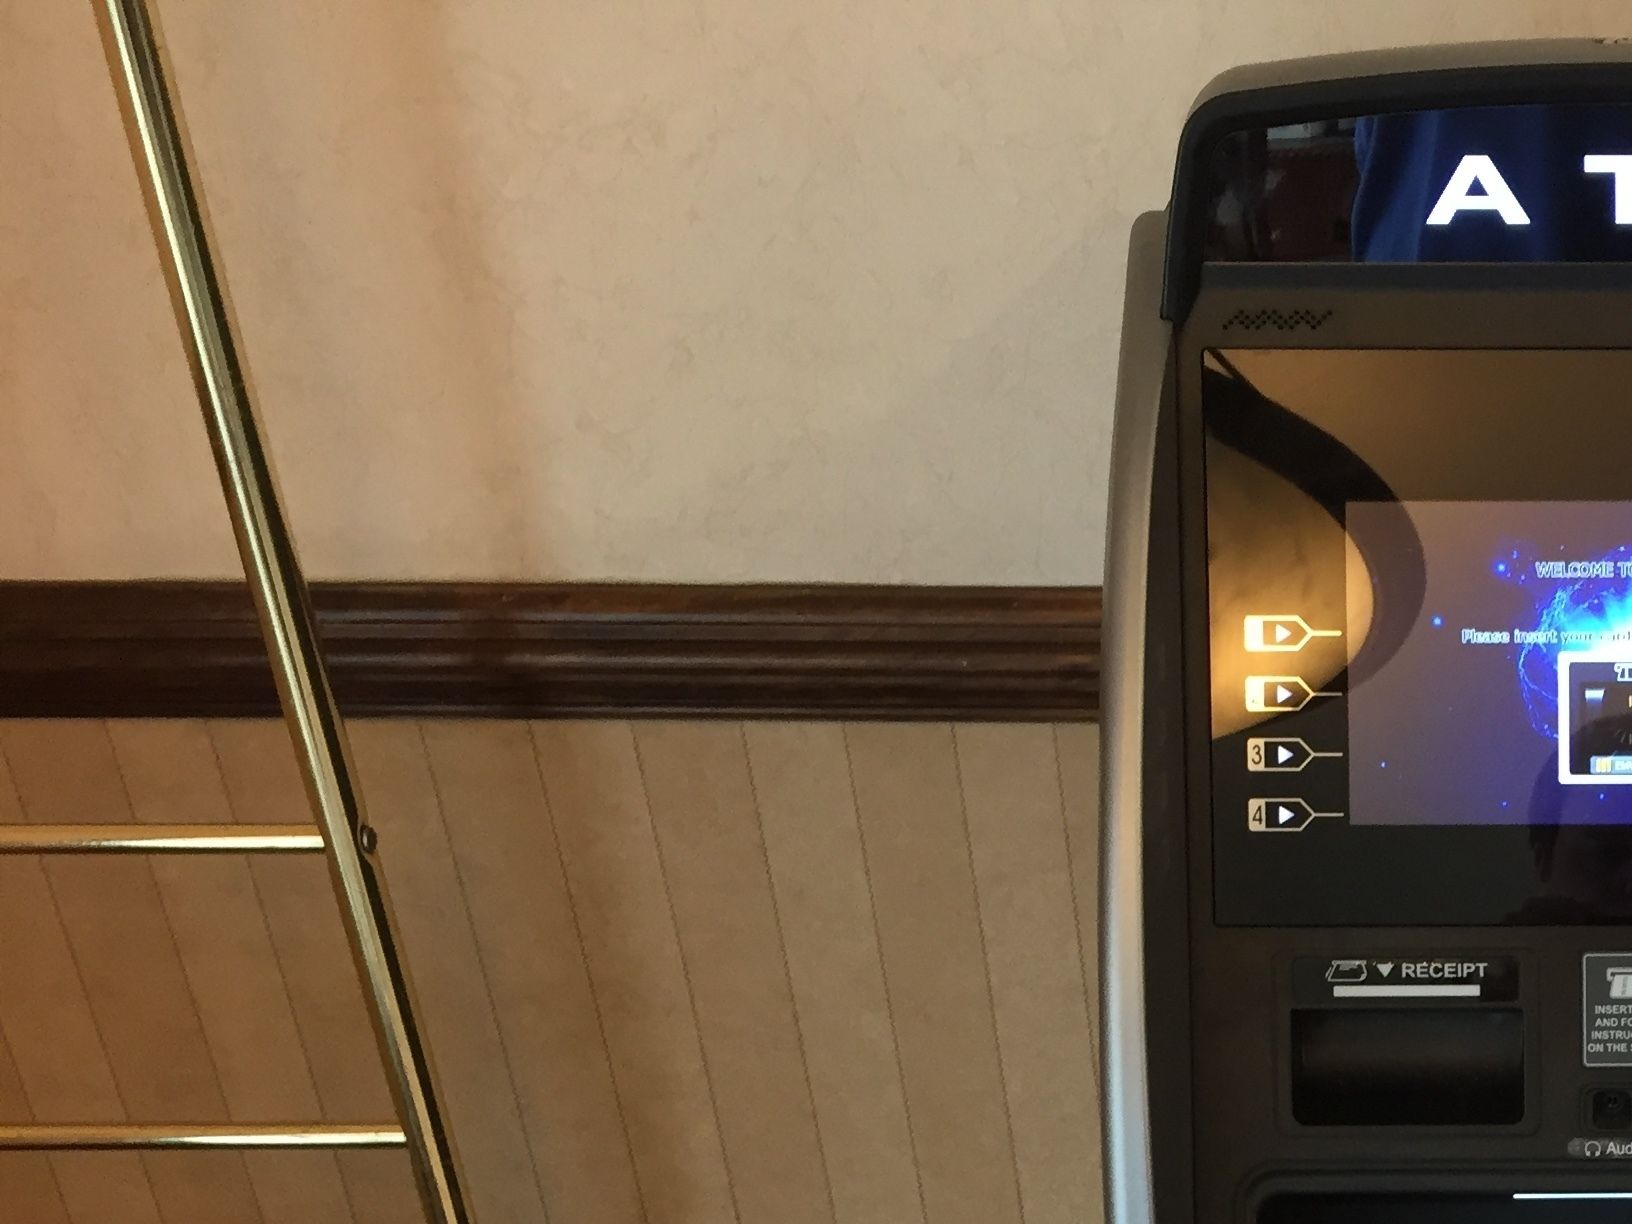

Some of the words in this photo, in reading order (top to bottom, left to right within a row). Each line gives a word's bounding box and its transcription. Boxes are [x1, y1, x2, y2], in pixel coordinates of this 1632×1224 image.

[1535, 561, 1614, 578] WELCOME
[1461, 628, 1510, 644] Please
[1514, 628, 1558, 644] insert
[1560, 630, 1593, 643] your
[1251, 744, 1263, 765] 3
[1251, 805, 1264, 826] 4
[1401, 962, 1488, 978] RECEIPT
[1595, 1018, 1618, 1027] AND
[1587, 1043, 1604, 1053] ON
[1606, 1043, 1628, 1052] THE
